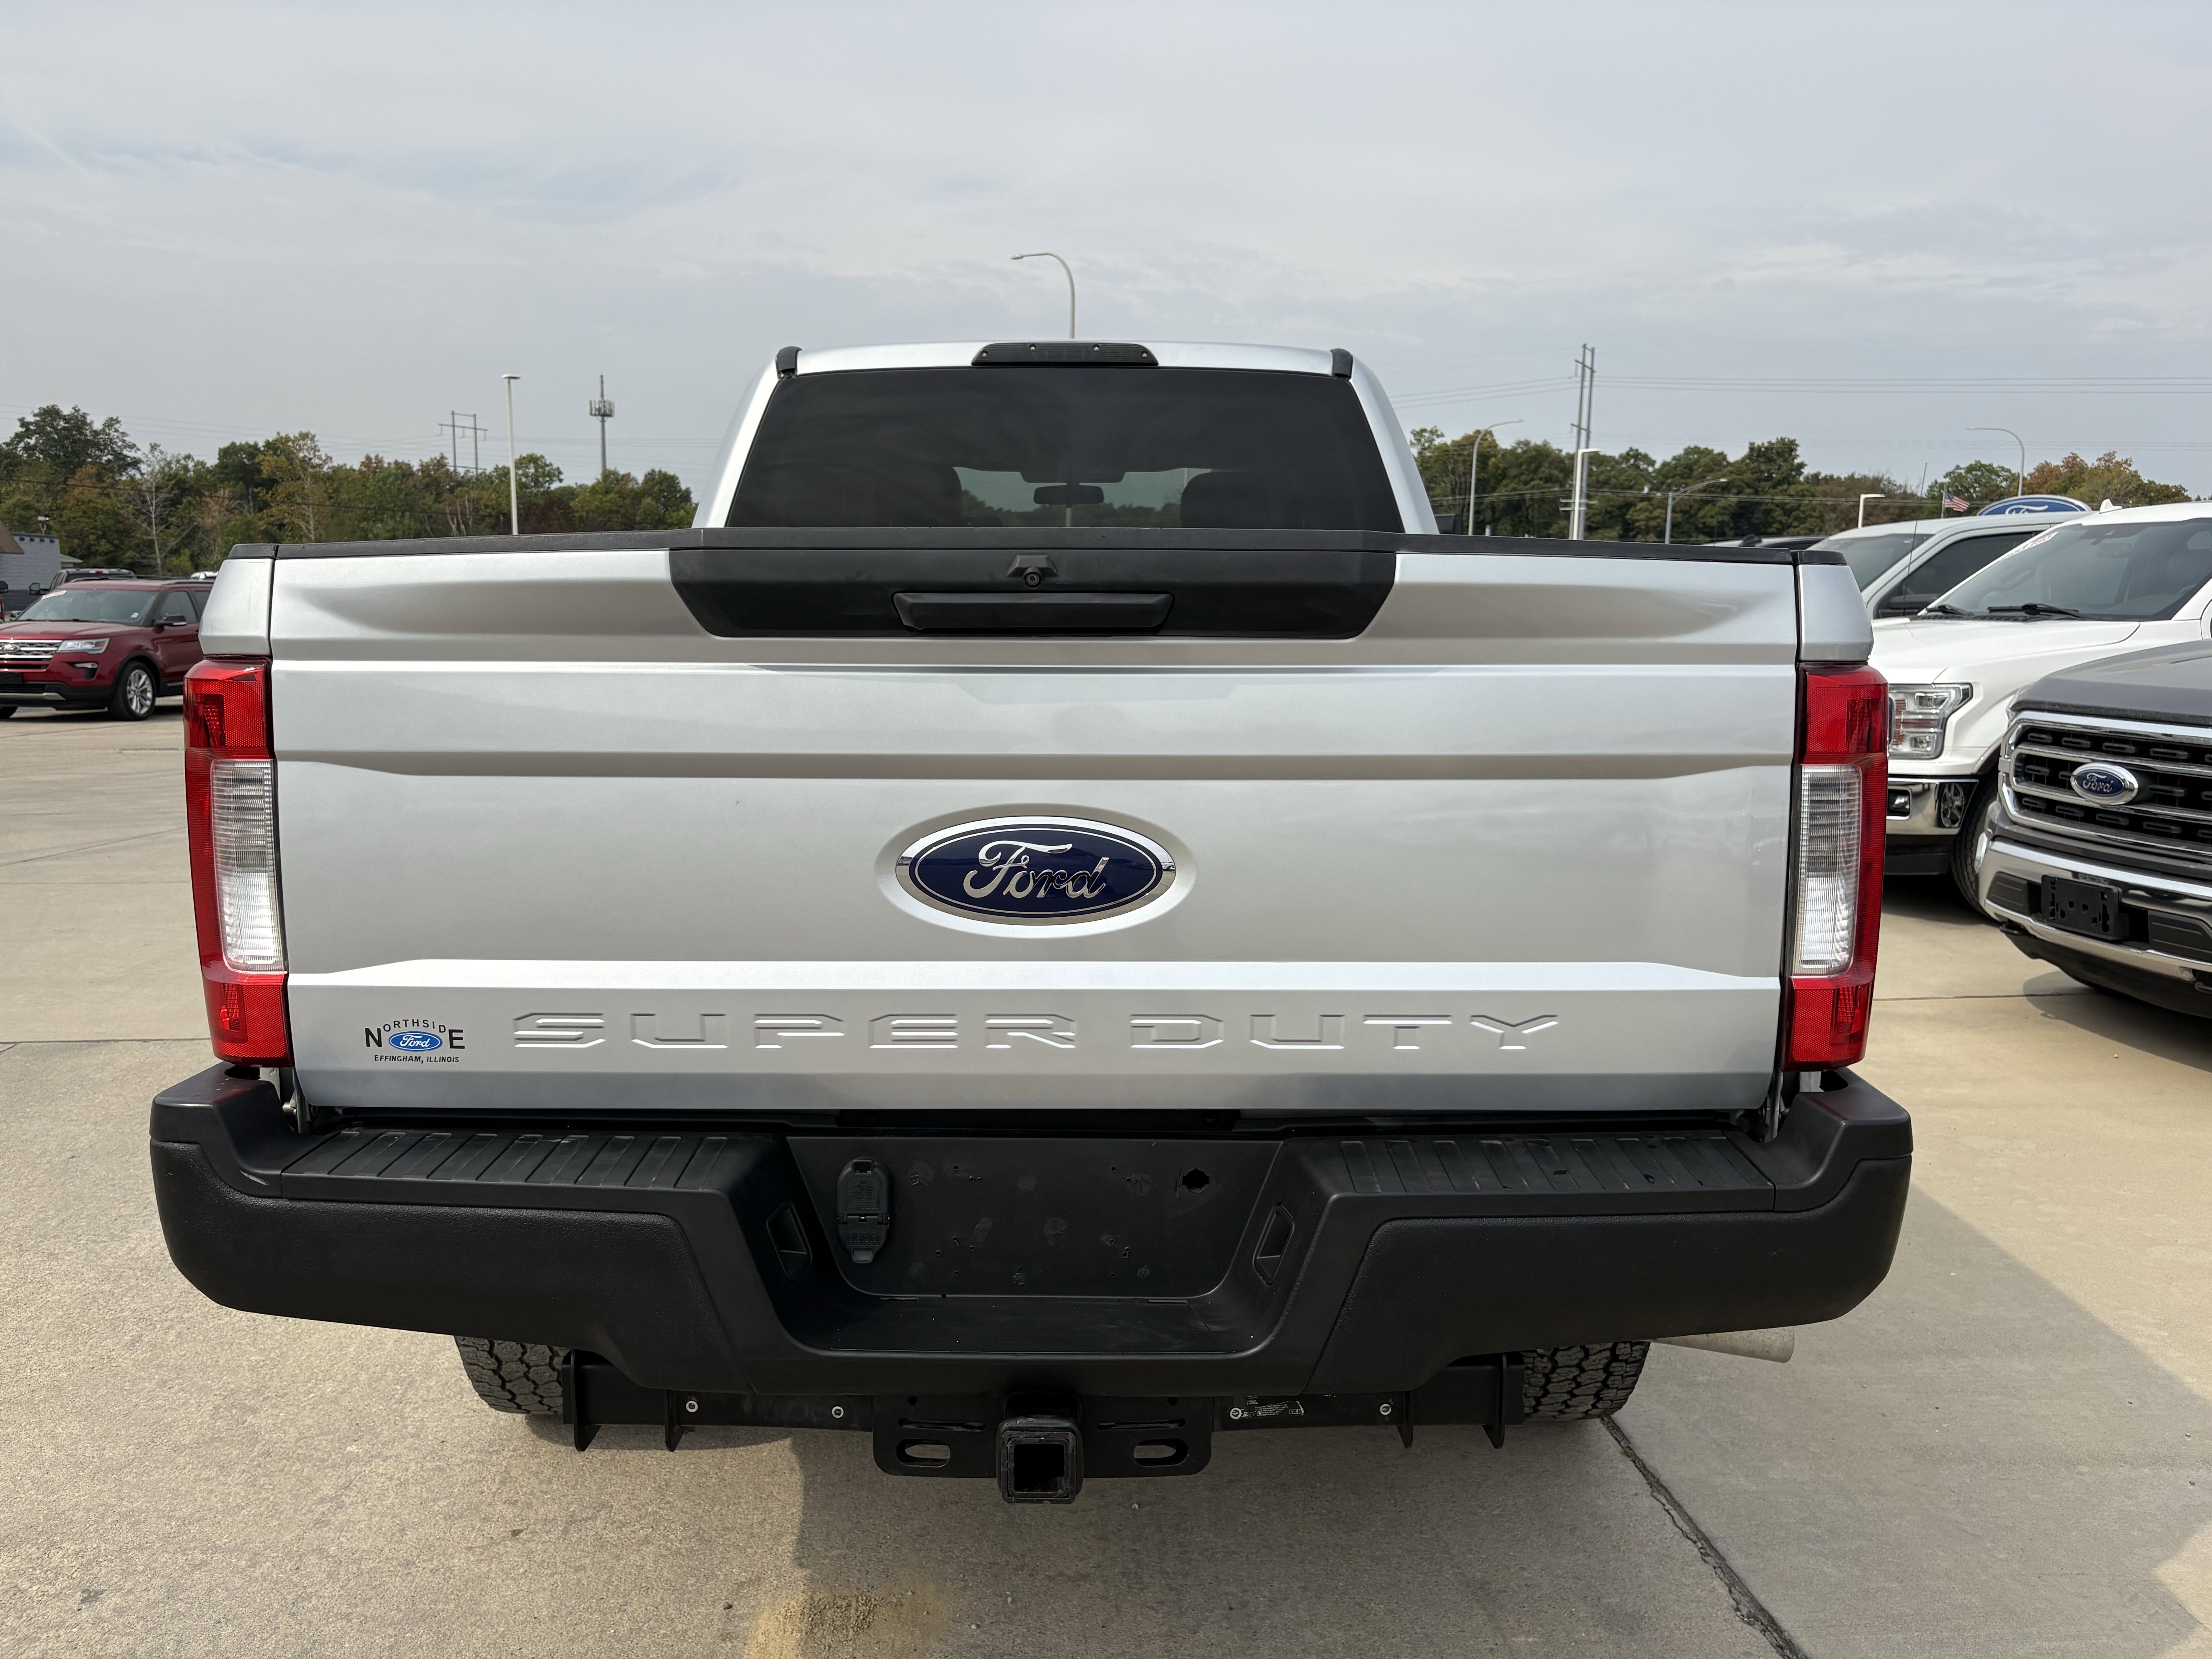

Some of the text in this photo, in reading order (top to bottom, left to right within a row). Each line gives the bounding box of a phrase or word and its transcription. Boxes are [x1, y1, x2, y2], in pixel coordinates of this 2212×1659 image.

[2083, 772, 2113, 793] Ford
[963, 840, 1109, 898] Ford
[364, 1018, 465, 1049] NORTHSIDE
[399, 1034, 431, 1048] Ford
[513, 1012, 1559, 1050] SUPER DUTY
[374, 1054, 424, 1064] EFFINGHAM,
